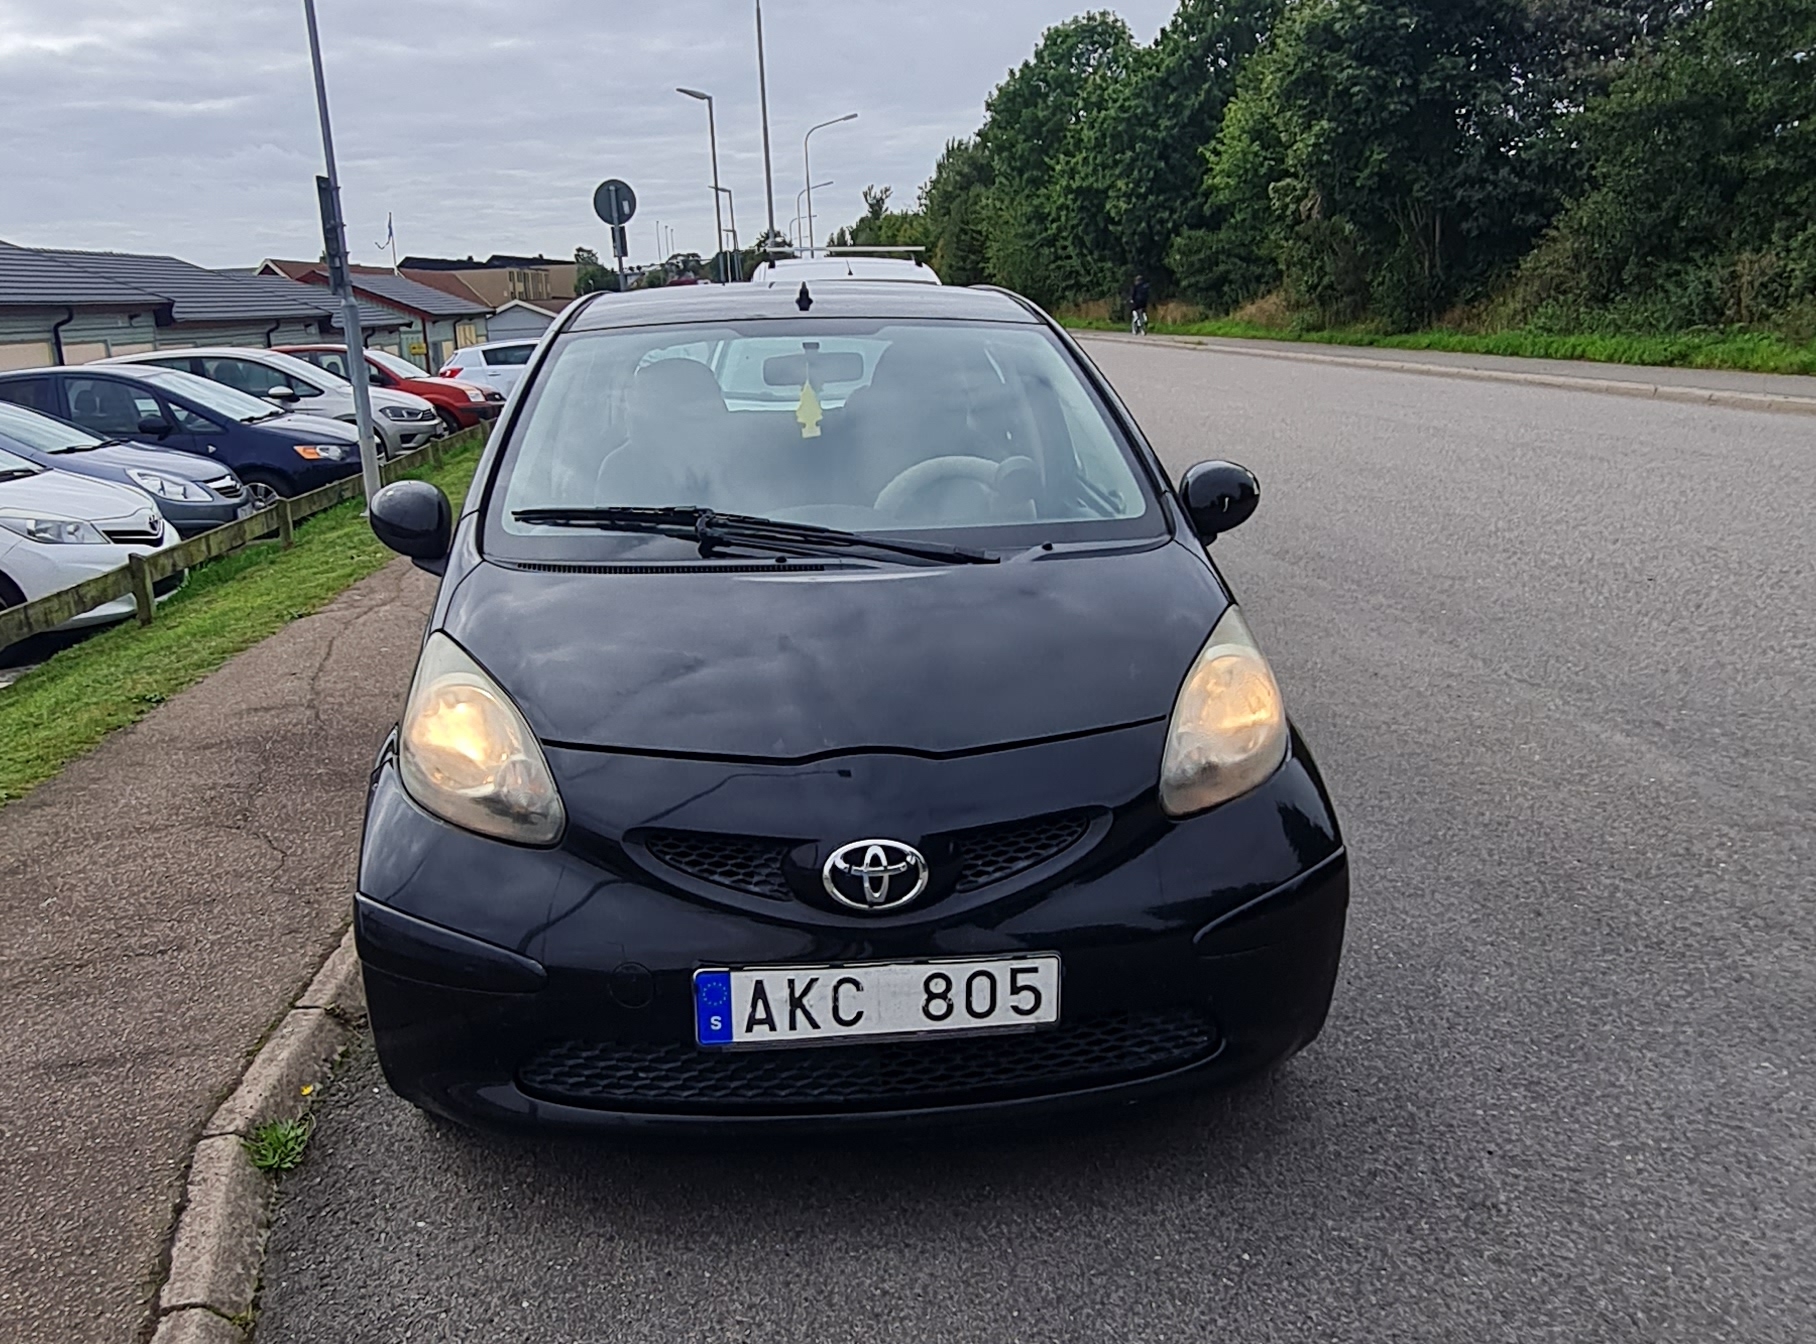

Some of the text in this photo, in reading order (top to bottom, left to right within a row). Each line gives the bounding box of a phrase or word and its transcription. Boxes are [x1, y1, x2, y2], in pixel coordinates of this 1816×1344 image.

[744, 966, 1042, 1033] AKC 805
[710, 1016, 722, 1031] S
